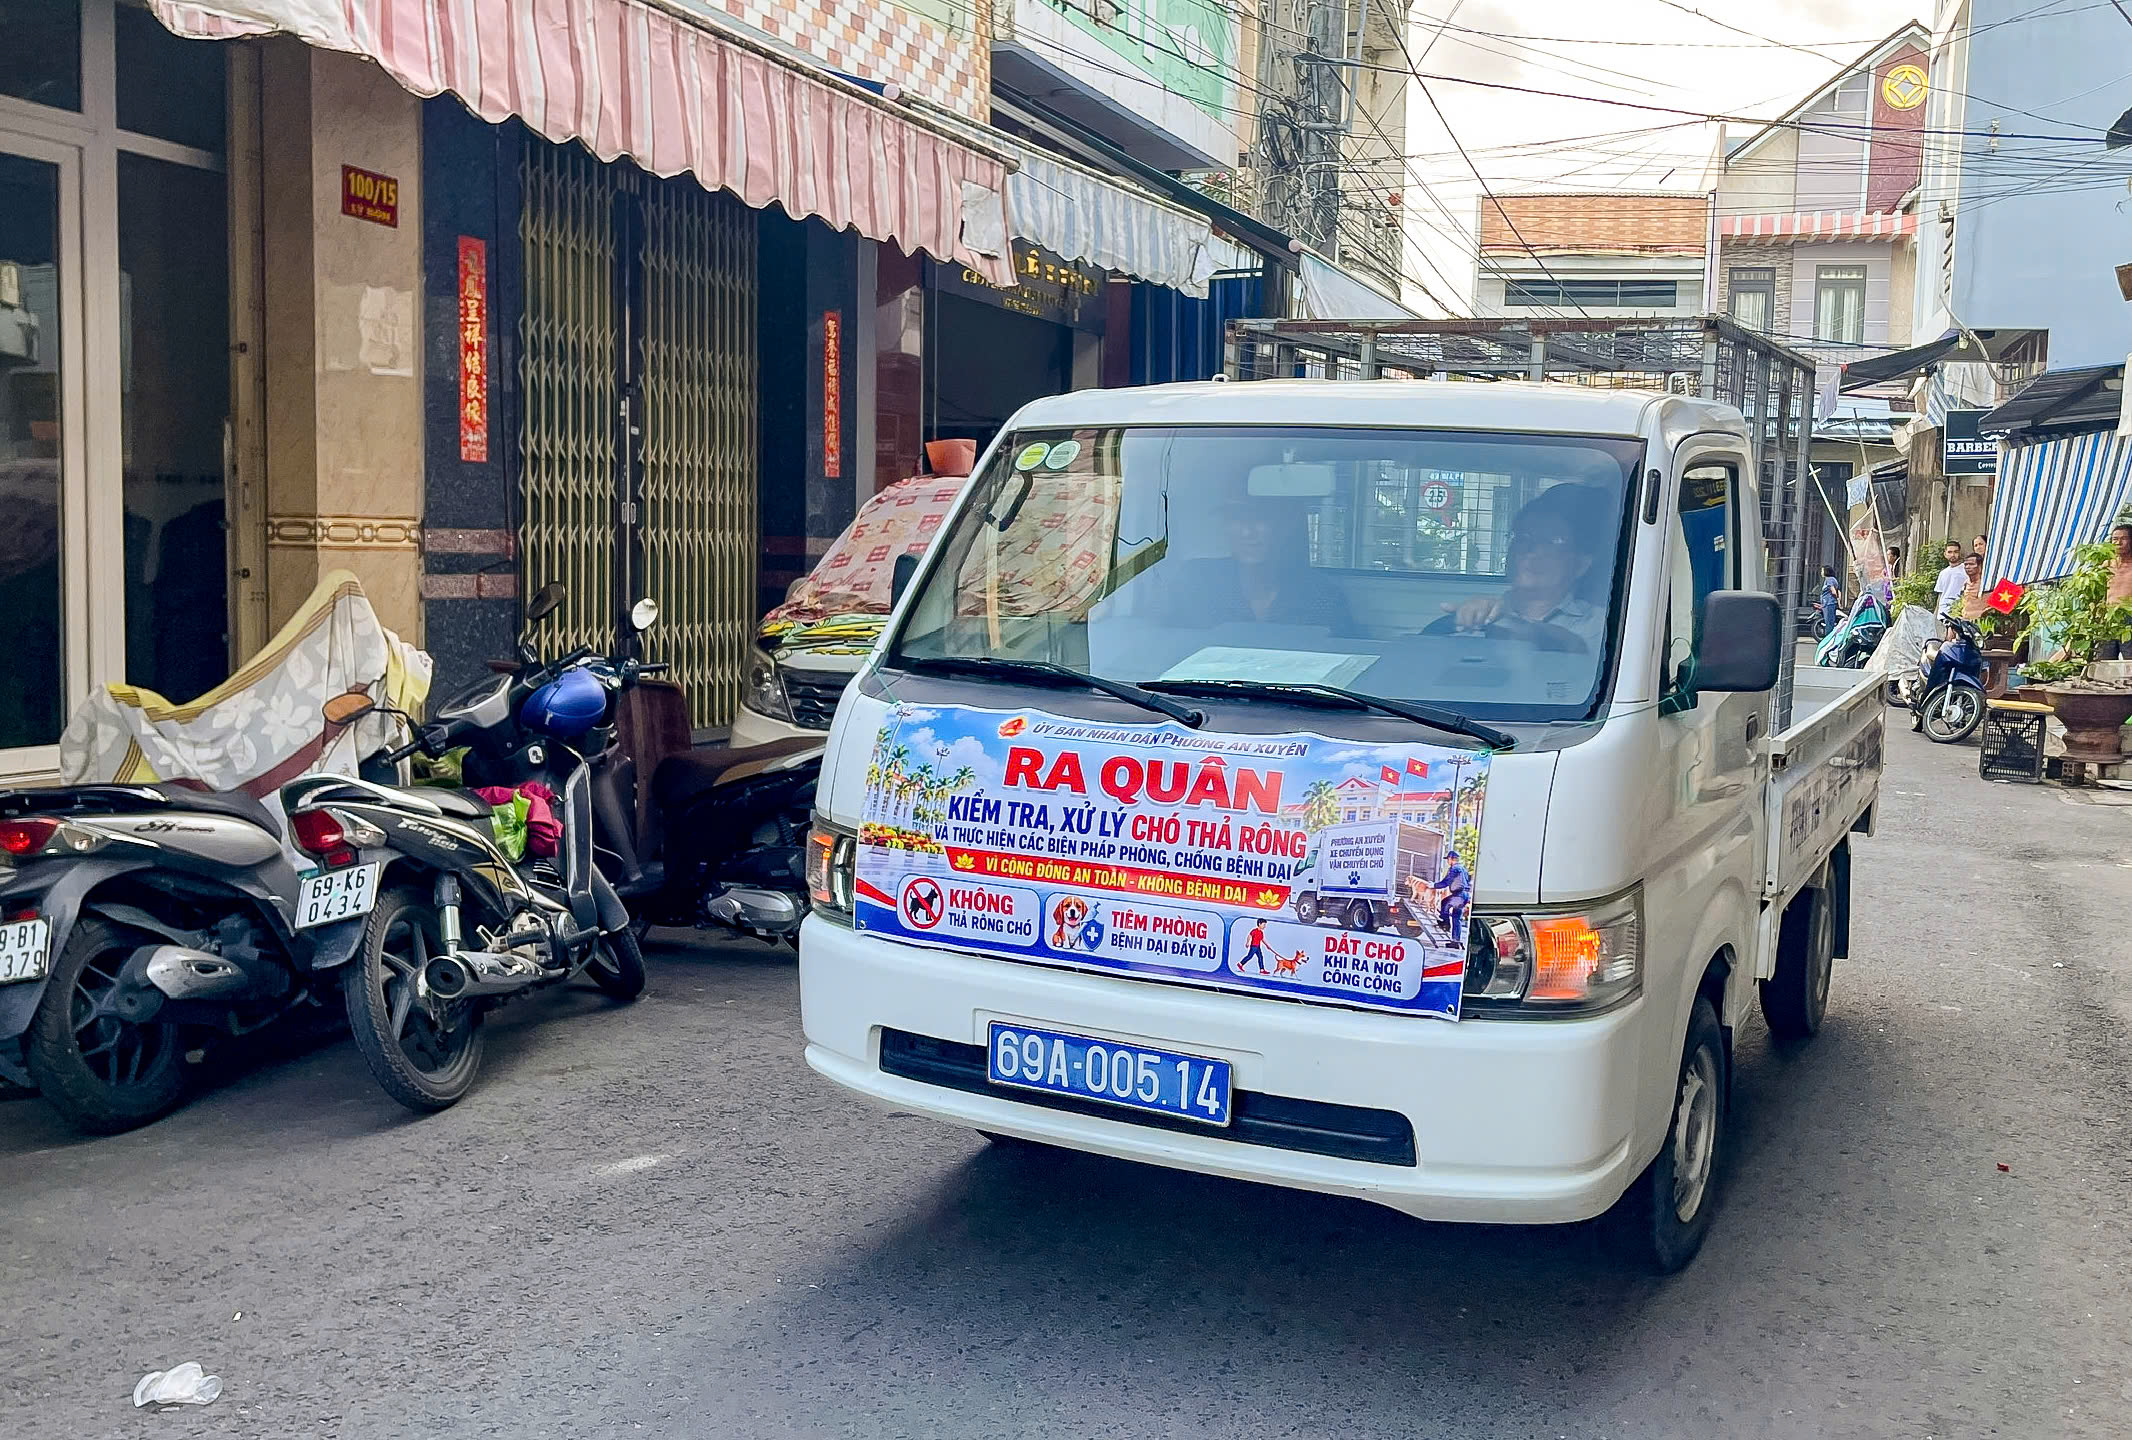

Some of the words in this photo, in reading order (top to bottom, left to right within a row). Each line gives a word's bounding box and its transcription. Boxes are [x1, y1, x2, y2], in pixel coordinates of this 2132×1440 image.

[349, 172, 396, 206] 100/15
[1033, 722, 1053, 734] ỦY
[1054, 726, 1087, 738] BAN
[1086, 727, 1129, 742] NHÂN
[1129, 731, 1161, 745] DÂN
[1161, 732, 1226, 750] PHƯỜNG
[1227, 742, 1251, 752] AN
[1253, 742, 1309, 757] XUYÊN
[1003, 747, 1087, 794] RA
[1100, 756, 1283, 814] QUÂN
[948, 789, 1001, 825] KIỂM
[1008, 802, 1055, 834] TRA,
[1059, 801, 1097, 834] XỬ
[1099, 807, 1127, 838] LÝ
[1131, 812, 1180, 844] CHÓ
[1187, 816, 1232, 851] THẢ
[1239, 822, 1306, 858] RÔNG
[935, 823, 948, 841] VÀ
[953, 827, 983, 846] THỰC
[986, 829, 1015, 850] HIỆN
[1019, 830, 1044, 851] CÁC
[1050, 836, 1077, 857] BIỆN
[1081, 840, 1116, 858] PHÁP
[1119, 844, 1170, 868] PHÒNG,
[1174, 850, 1222, 874] CHỐNG
[1226, 854, 1263, 879] BỆNH
[1267, 862, 1291, 883] DẠI
[1330, 850, 1338, 858] XE
[1365, 847, 1384, 858] DỤNG
[1355, 836, 1364, 845] AN
[1364, 833, 1385, 844] XUYÊN
[1330, 859, 1342, 870] VẬN
[1370, 857, 1384, 868] CHÓ
[312, 868, 366, 899] 69-K6
[985, 855, 998, 872] VÌ
[1000, 857, 1033, 877] CỘNG
[1036, 860, 1070, 880] ĐỒNG
[1073, 867, 1091, 883] AN
[1094, 866, 1127, 888] TOÀN
[1137, 875, 1183, 894] KHÔNG
[1186, 881, 1221, 900] BỆNH
[1224, 887, 1247, 905] DẠI
[308, 891, 362, 922] 0434
[949, 887, 1013, 915] KHÔNG
[948, 910, 967, 928] THẢ
[972, 914, 1003, 932] RÔNG
[1007, 919, 1032, 936] CHÓ
[1112, 910, 1148, 932] TIÊM
[1152, 917, 1208, 939] PHÒNG
[1111, 932, 1142, 950] BỆNH
[1146, 938, 1168, 956] DẠI
[1171, 938, 1196, 955] ĐẦY
[1199, 942, 1217, 960] ĐỦ
[1325, 932, 1361, 955] DẮT
[1365, 942, 1405, 962] CHÓ
[3, 951, 42, 978] 3.79
[1324, 955, 1347, 969] KHI
[1352, 958, 1369, 972] RA
[1374, 962, 1398, 976] NƠI
[1323, 970, 1360, 987] CÔNG
[1363, 975, 1402, 993] CỘNG
[996, 1031, 1220, 1115] 69A-005.14
